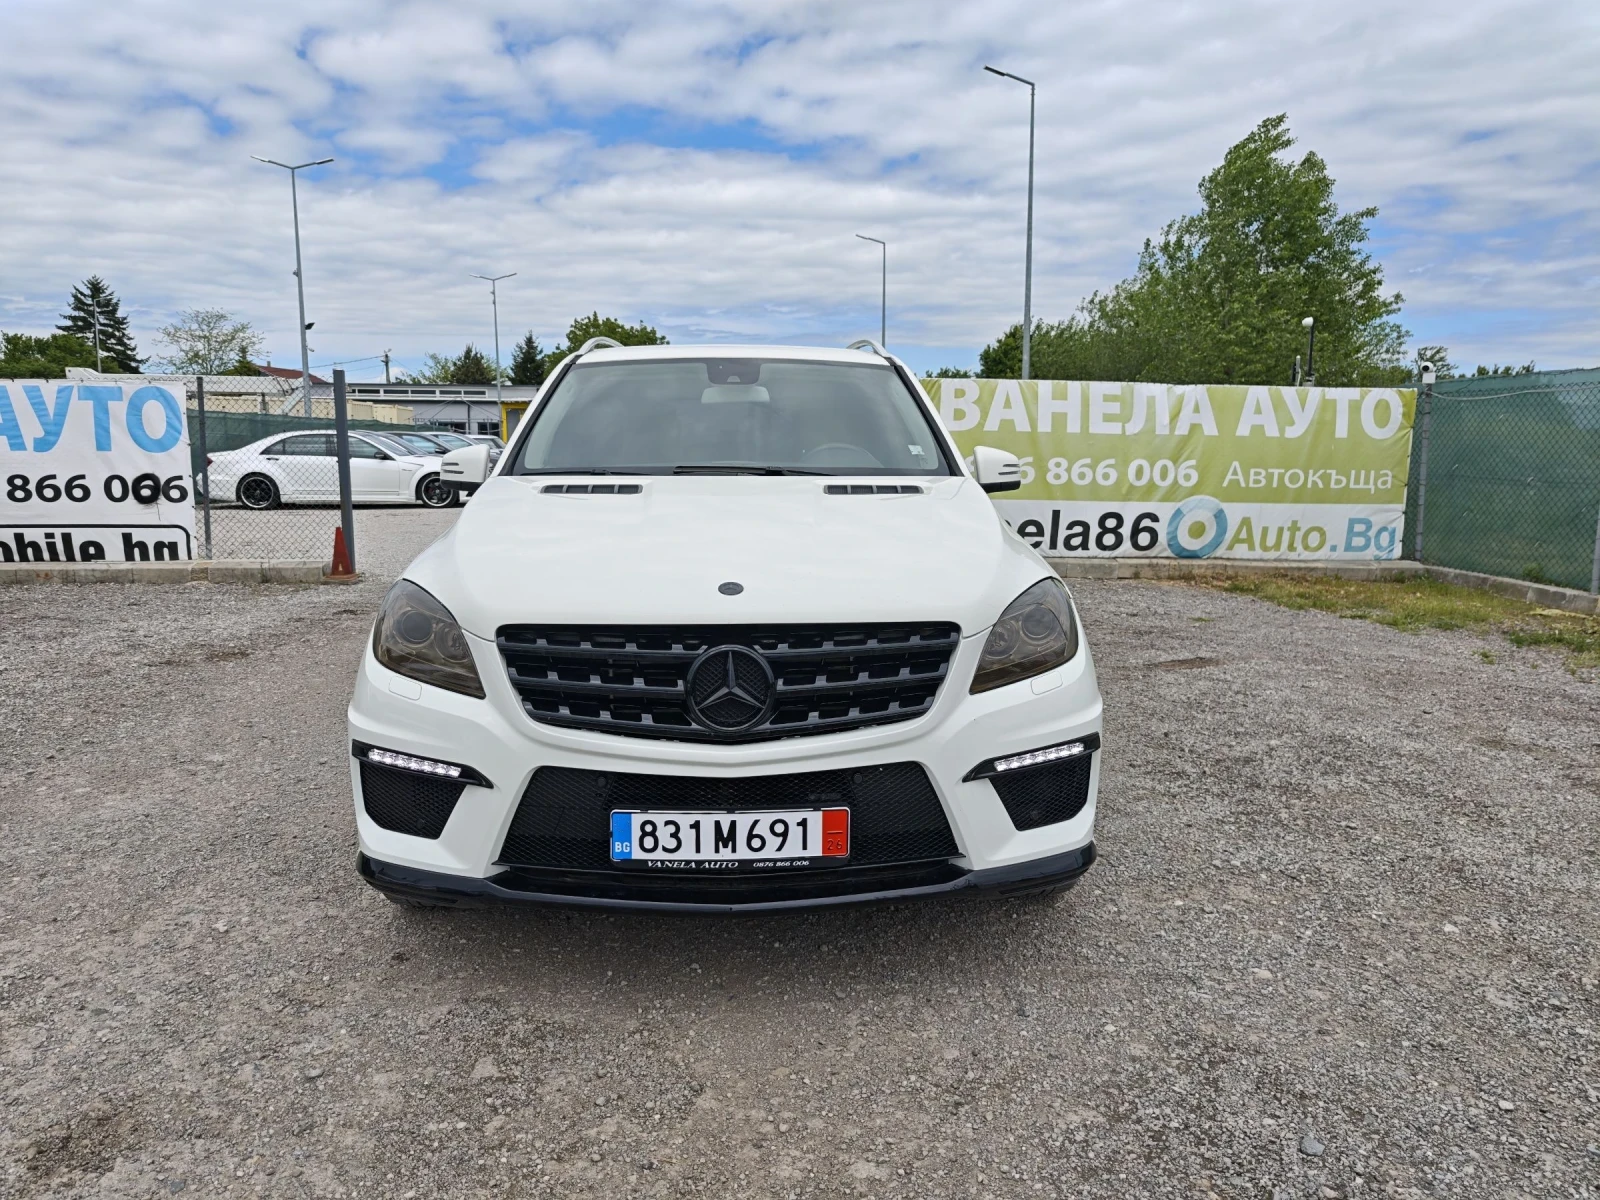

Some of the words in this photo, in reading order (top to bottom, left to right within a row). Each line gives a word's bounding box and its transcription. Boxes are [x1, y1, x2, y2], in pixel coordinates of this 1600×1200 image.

[939, 378, 1219, 437] ВАНЕЛА
[1235, 386, 1404, 440] АУТО
[1045, 456, 1119, 487] 866
[1127, 458, 1199, 487] 006
[1222, 460, 1393, 495] Автокъща
[6, 473, 92, 503] 866
[1005, 509, 1161, 552] ela86
[614, 841, 631, 853] BG
[827, 838, 843, 851] 26
[647, 860, 697, 869] VANELA
[700, 860, 739, 869] AUTO
